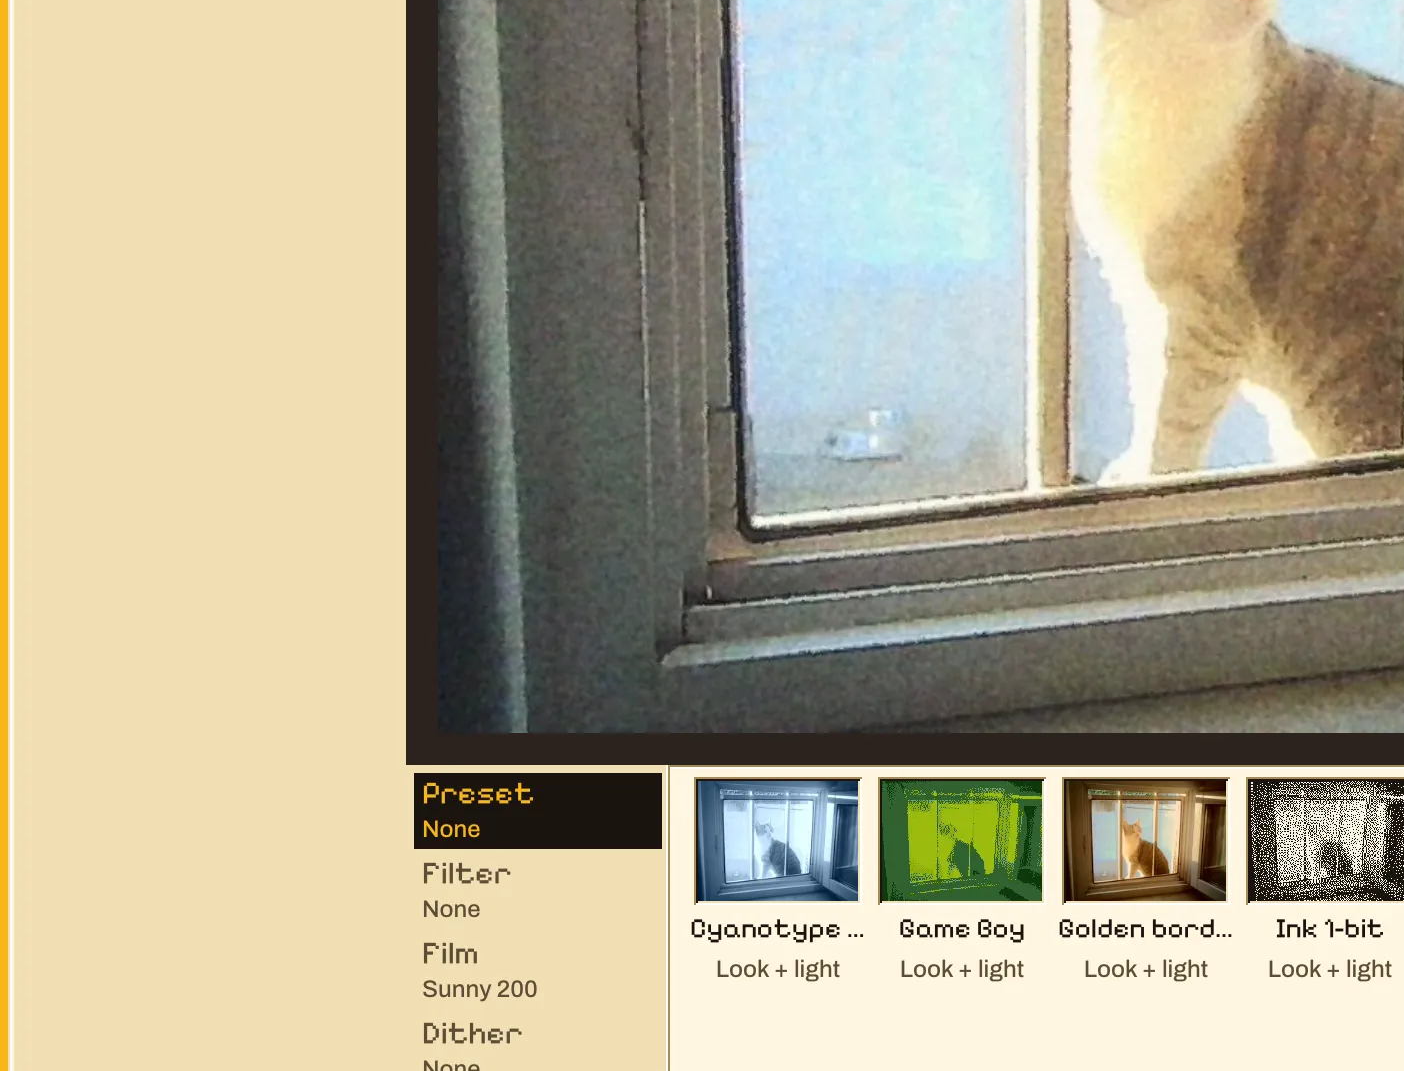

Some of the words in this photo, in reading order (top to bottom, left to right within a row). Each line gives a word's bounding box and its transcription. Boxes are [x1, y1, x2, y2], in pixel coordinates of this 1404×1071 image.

[423, 782, 534, 805] Preset
[423, 819, 481, 838] None
[423, 862, 511, 885] Filter
[423, 899, 481, 918] None
[691, 918, 841, 944] Cyanotype
[899, 918, 970, 938] Game
[977, 918, 1025, 944] Boy
[1059, 918, 1145, 939] Golden
[1152, 918, 1232, 939] bord...
[1276, 918, 1317, 939] Ink
[1324, 918, 1384, 939] 1-bit
[423, 942, 478, 965] Film
[717, 958, 770, 978] Look
[794, 958, 841, 983] light
[422, 979, 492, 1002] Sunny
[497, 979, 538, 998] 200
[423, 1022, 523, 1045] Dither
